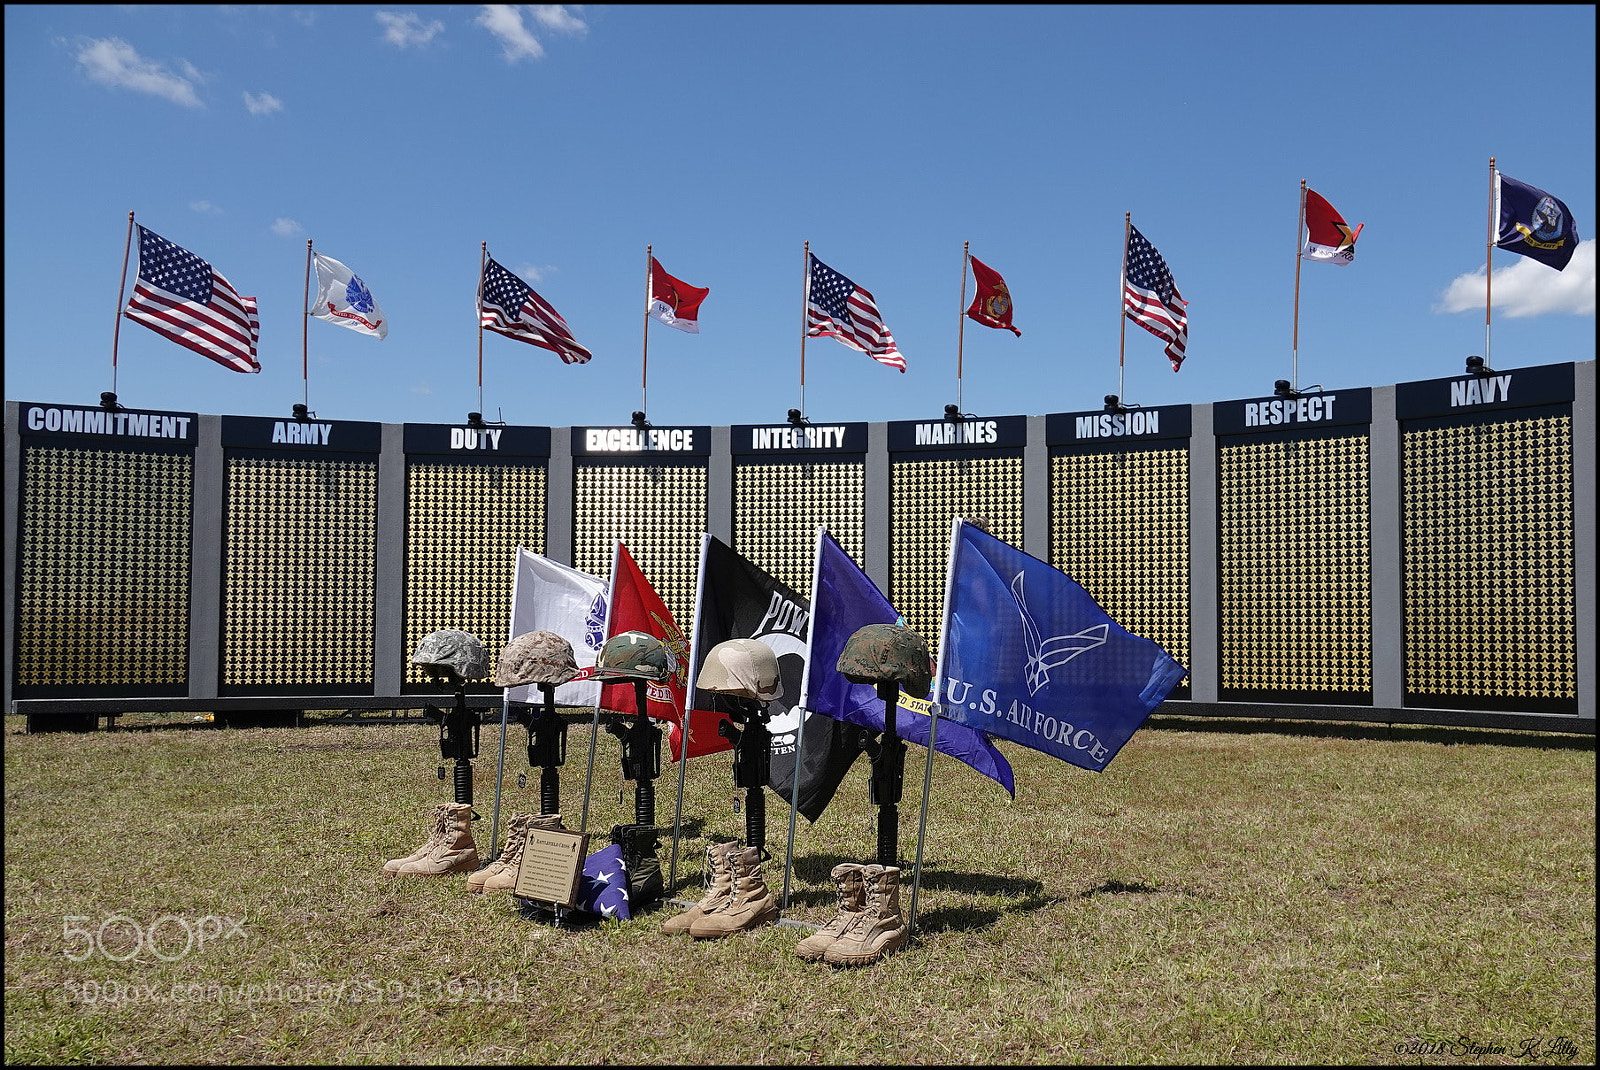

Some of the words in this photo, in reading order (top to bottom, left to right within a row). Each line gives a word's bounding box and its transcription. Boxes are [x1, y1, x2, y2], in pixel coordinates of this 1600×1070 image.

[1450, 375, 1512, 407] NAVY
[27, 406, 191, 440] COMMITMENT
[1075, 410, 1159, 439] MISSION
[1245, 395, 1336, 427] RESPECT
[271, 421, 333, 446] ARMY
[450, 428, 502, 451] DUTY
[585, 429, 693, 451] EXCELLENCE
[752, 426, 846, 450] INTEGRITY
[915, 420, 998, 446] MARINES
[750, 590, 810, 637] POW
[947, 677, 1001, 718] U.S.
[1005, 699, 1033, 731] AIR
[1034, 711, 1109, 764] FORCE
